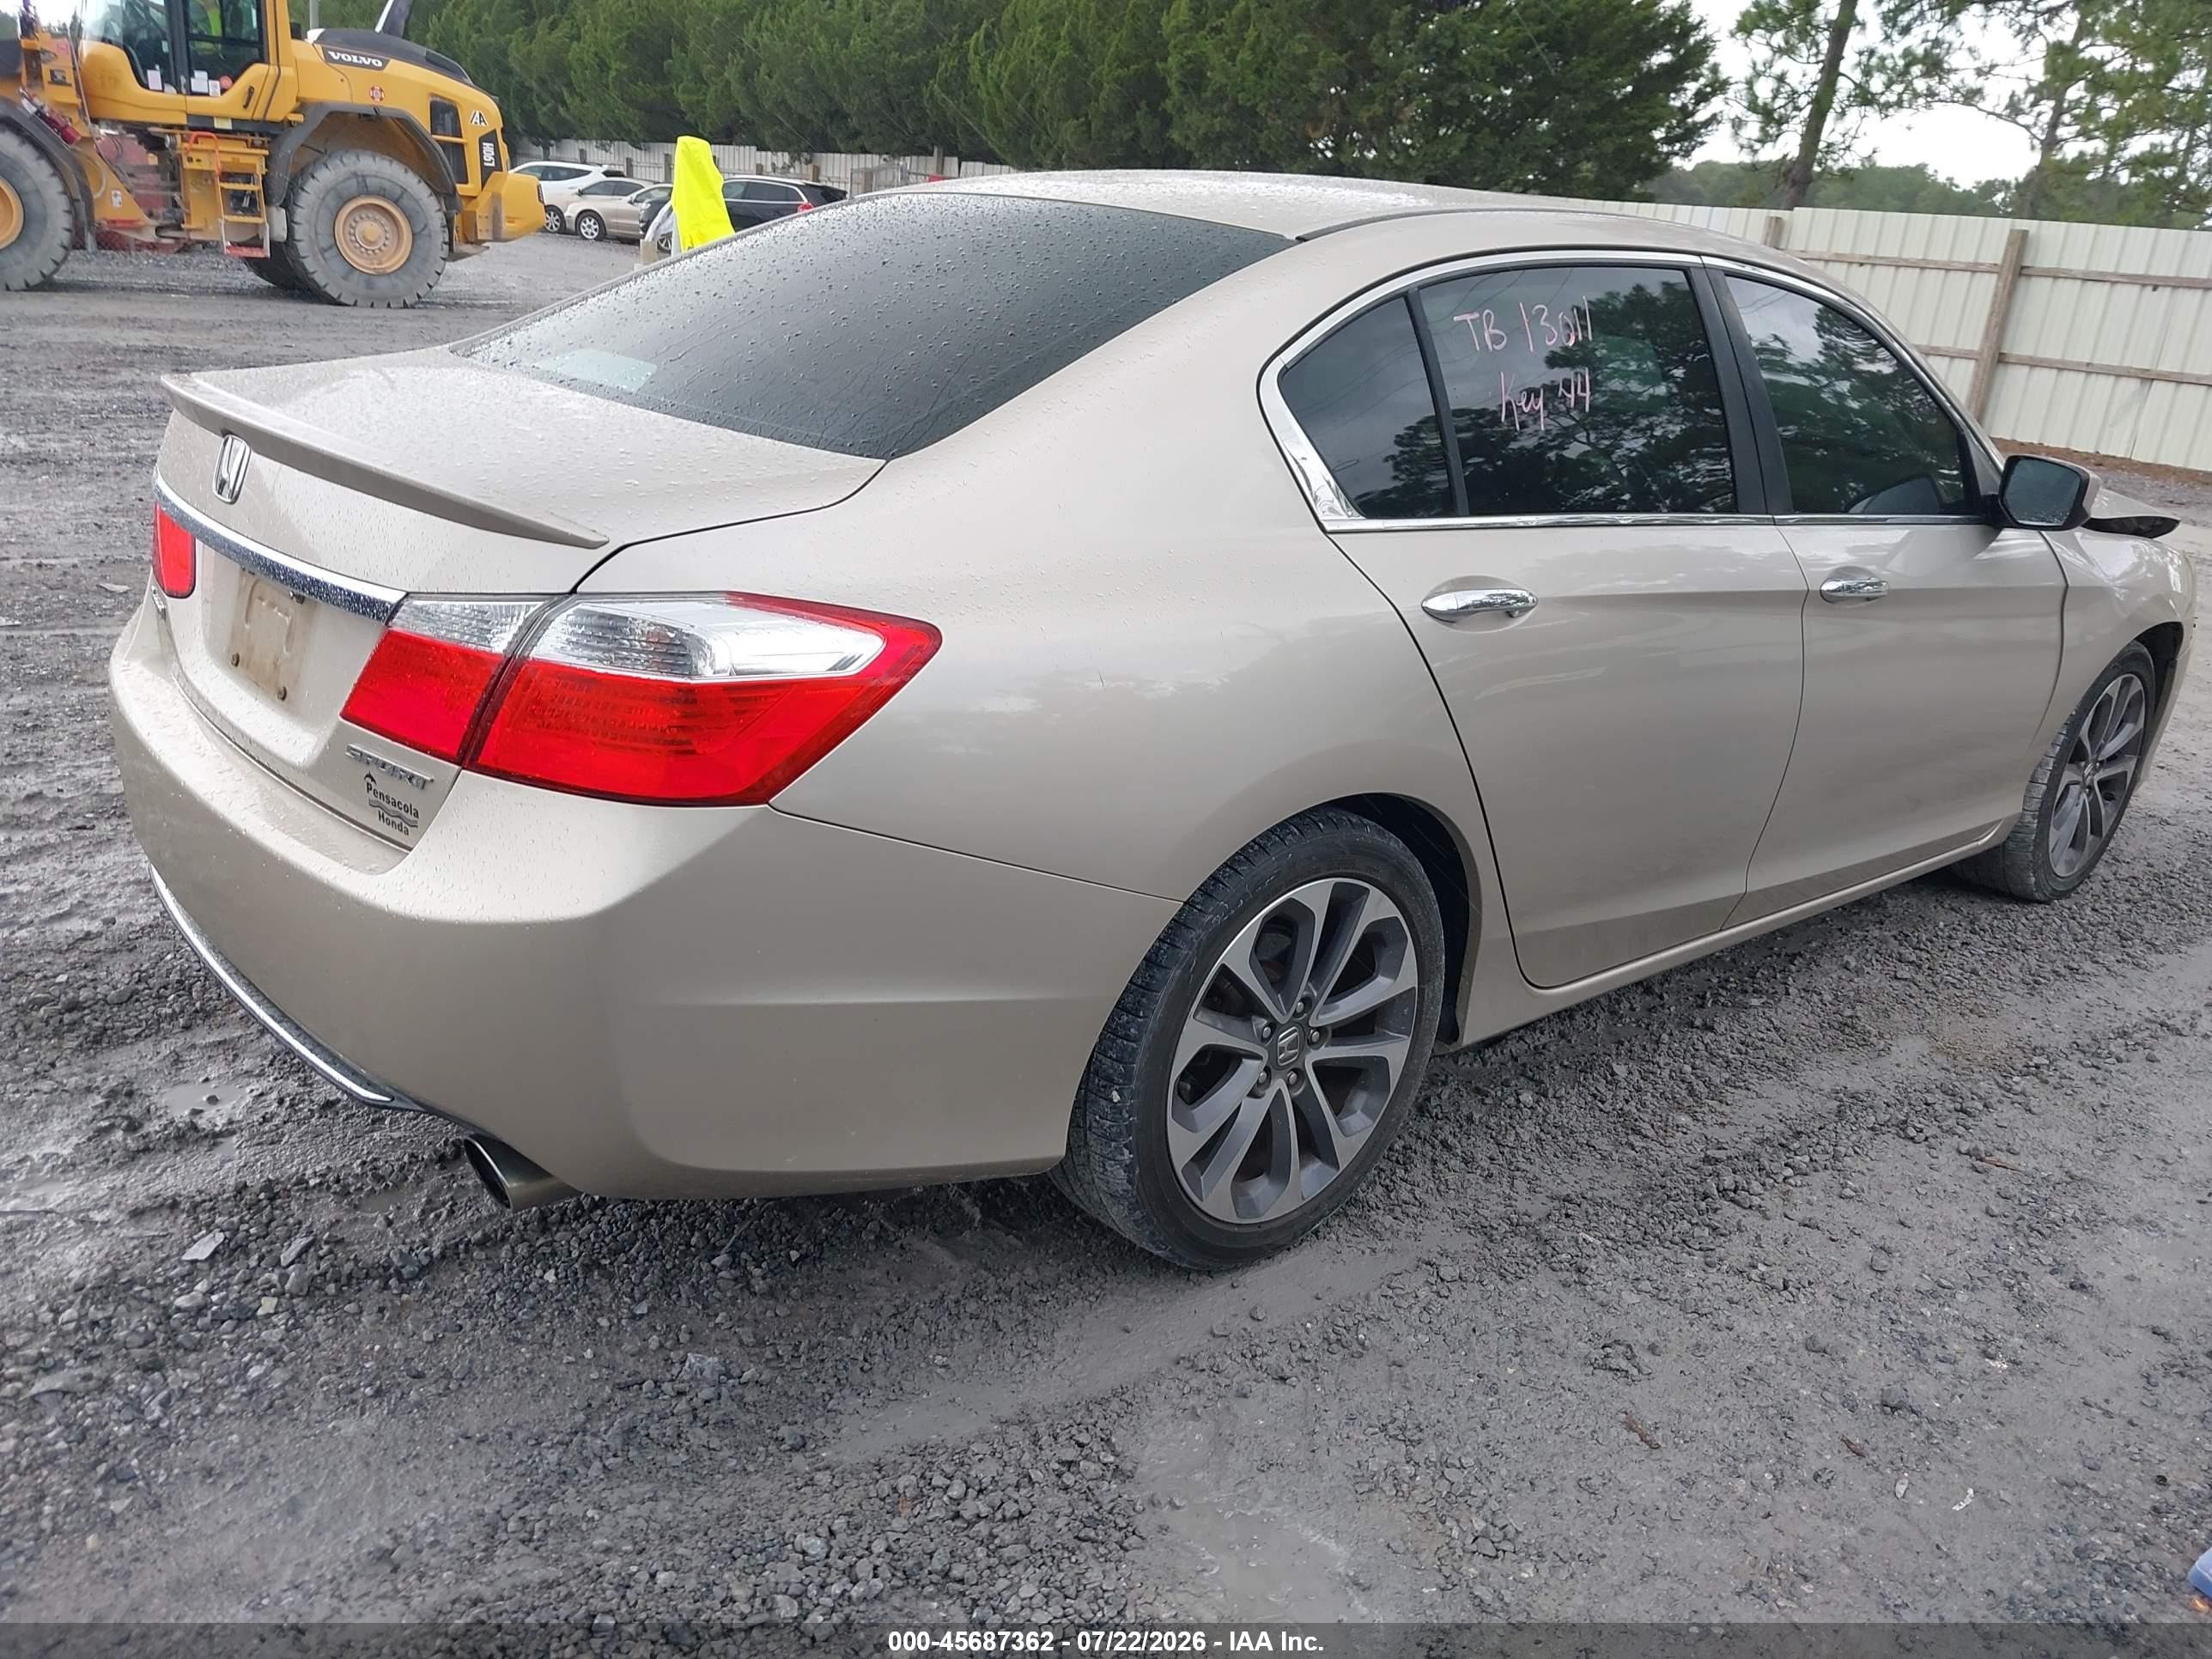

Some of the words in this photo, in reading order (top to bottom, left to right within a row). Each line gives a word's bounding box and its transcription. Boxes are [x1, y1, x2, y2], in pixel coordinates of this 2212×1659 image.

[327, 51, 383, 67] VOLVO
[482, 142, 495, 167] L90H
[1453, 308, 1508, 351] TB
[1499, 371, 1545, 432] Key
[345, 743, 434, 790] SPORT
[366, 781, 420, 819] Pensacola
[377, 810, 410, 836] Honda
